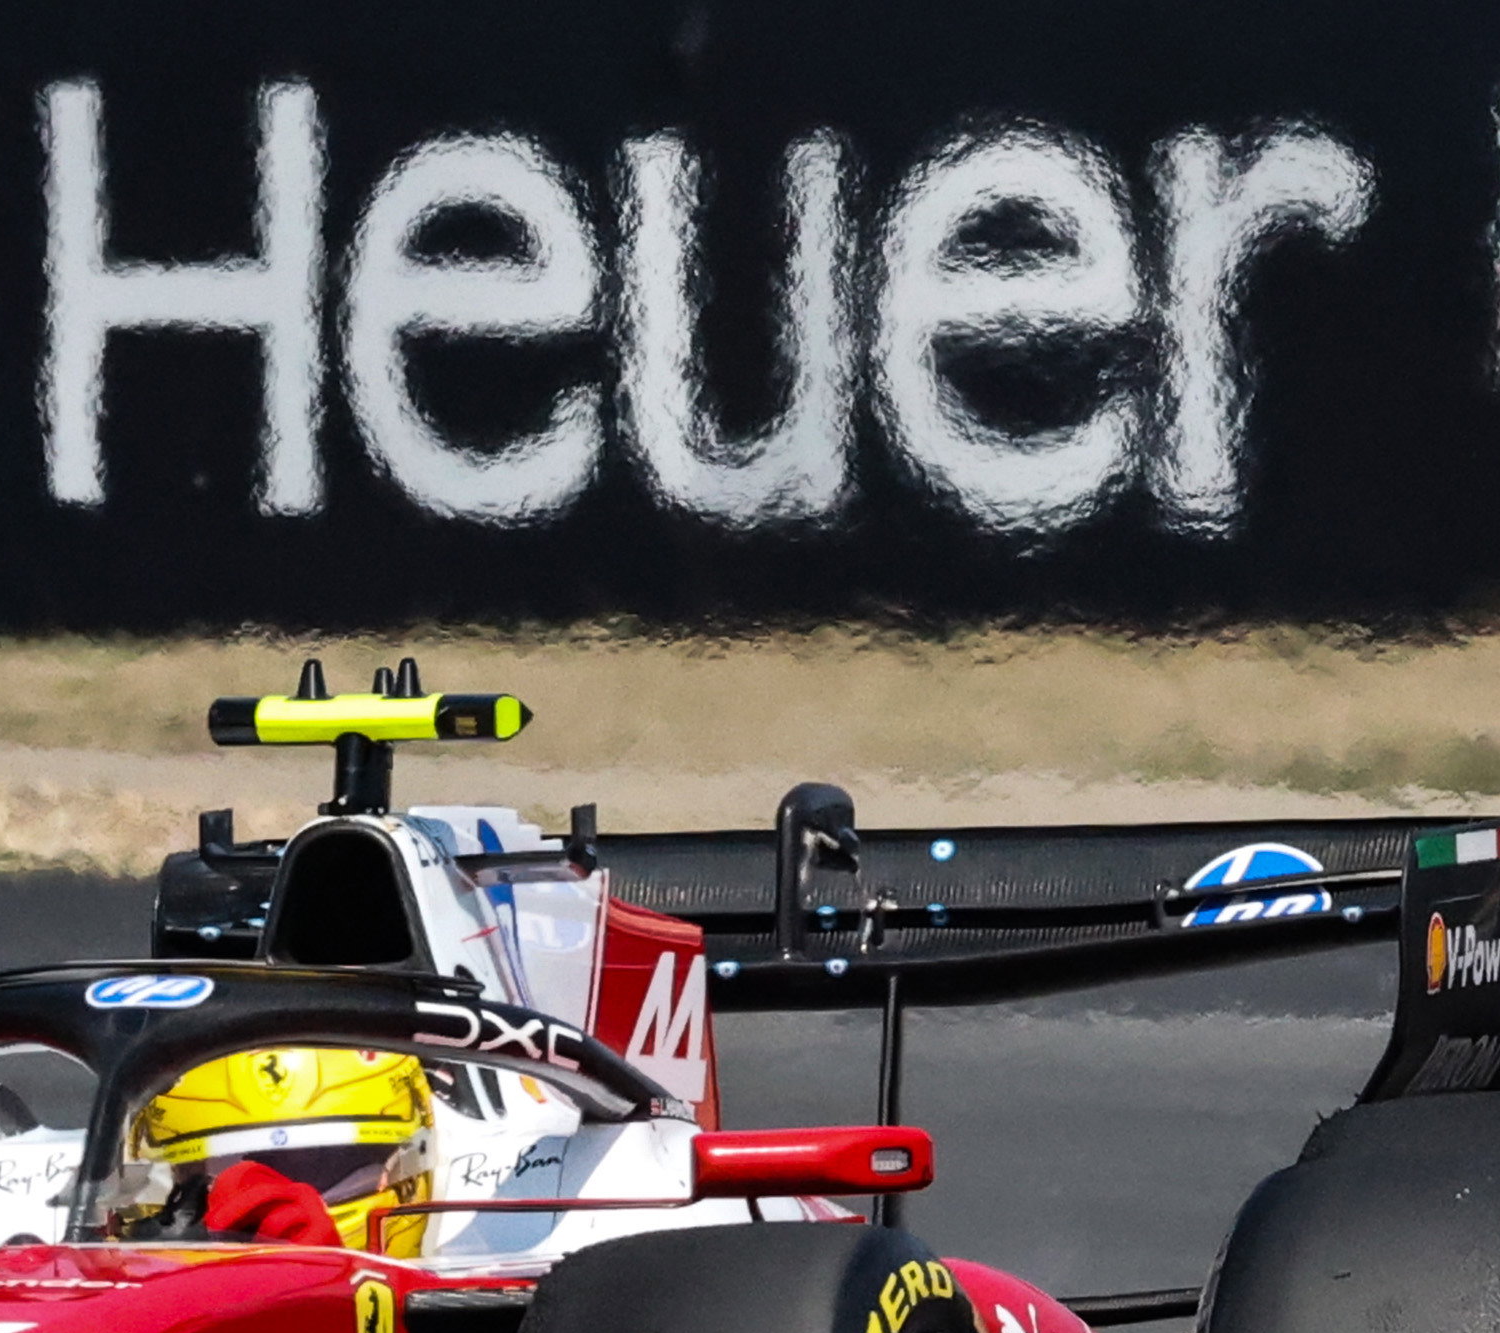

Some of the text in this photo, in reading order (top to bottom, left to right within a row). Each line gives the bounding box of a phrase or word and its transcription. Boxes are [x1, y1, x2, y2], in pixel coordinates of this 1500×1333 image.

[88, 975, 214, 1009] hp
[413, 1001, 584, 1071] DXC
[624, 951, 708, 1102] 44
[449, 1145, 562, 1187] Ray-Ban
